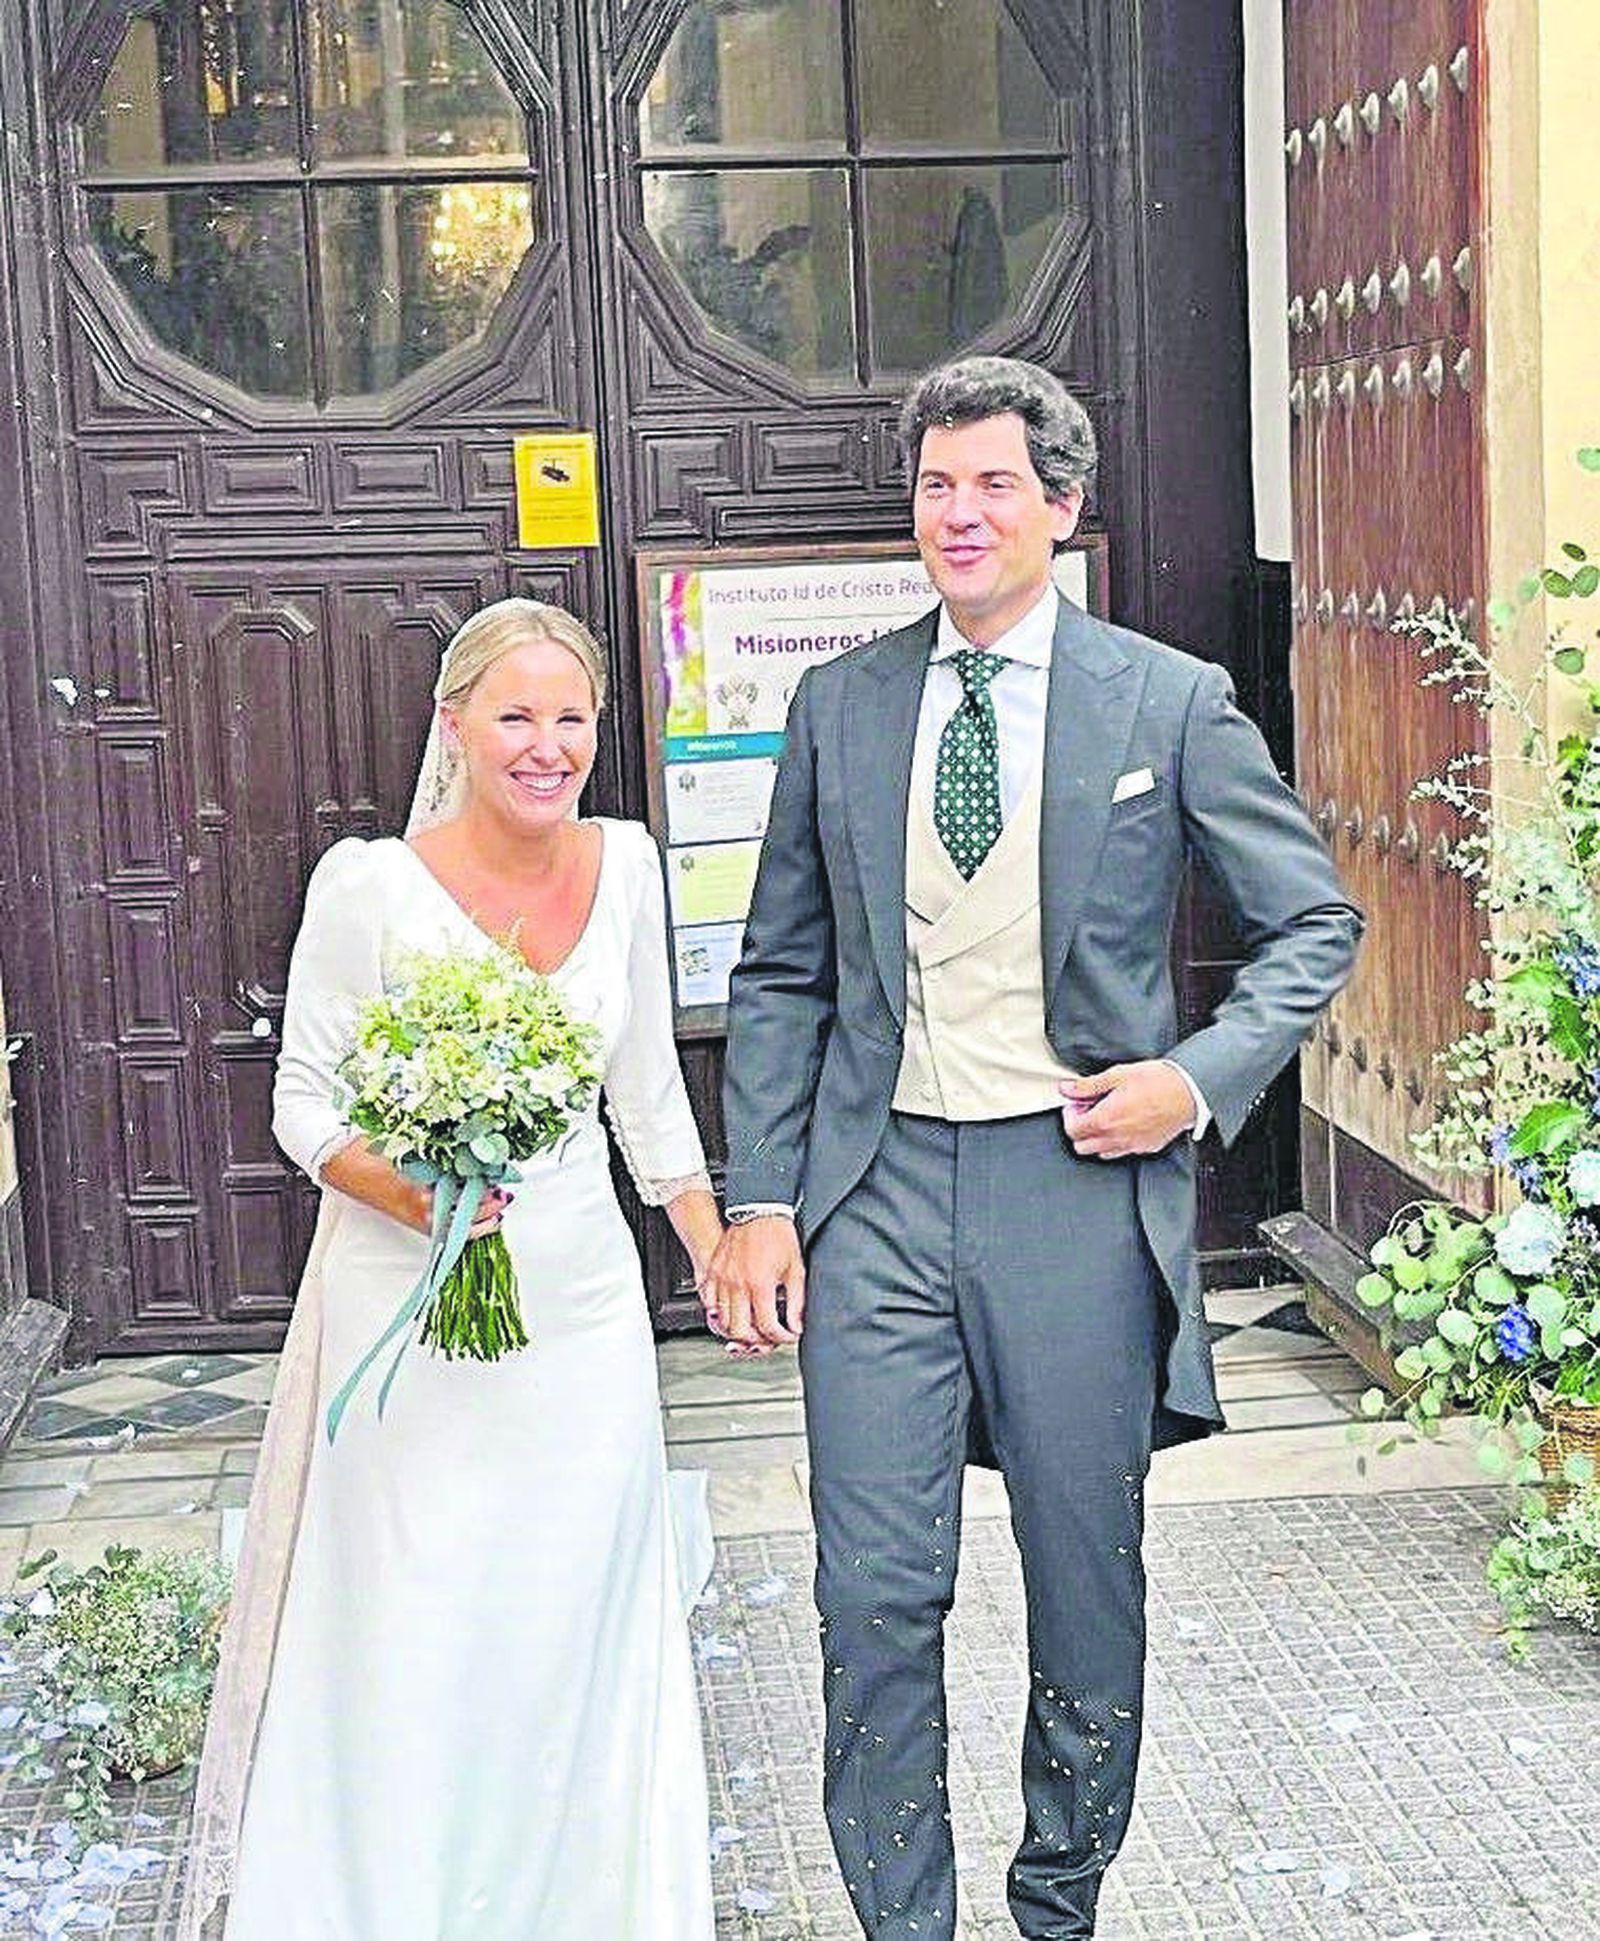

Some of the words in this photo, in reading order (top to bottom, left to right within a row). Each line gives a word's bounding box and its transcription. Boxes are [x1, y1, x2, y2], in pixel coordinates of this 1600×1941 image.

[709, 586, 787, 604] Instituto
[815, 583, 836, 600] de
[842, 580, 894, 598] Cristo
[735, 632, 864, 655] Misioneros
